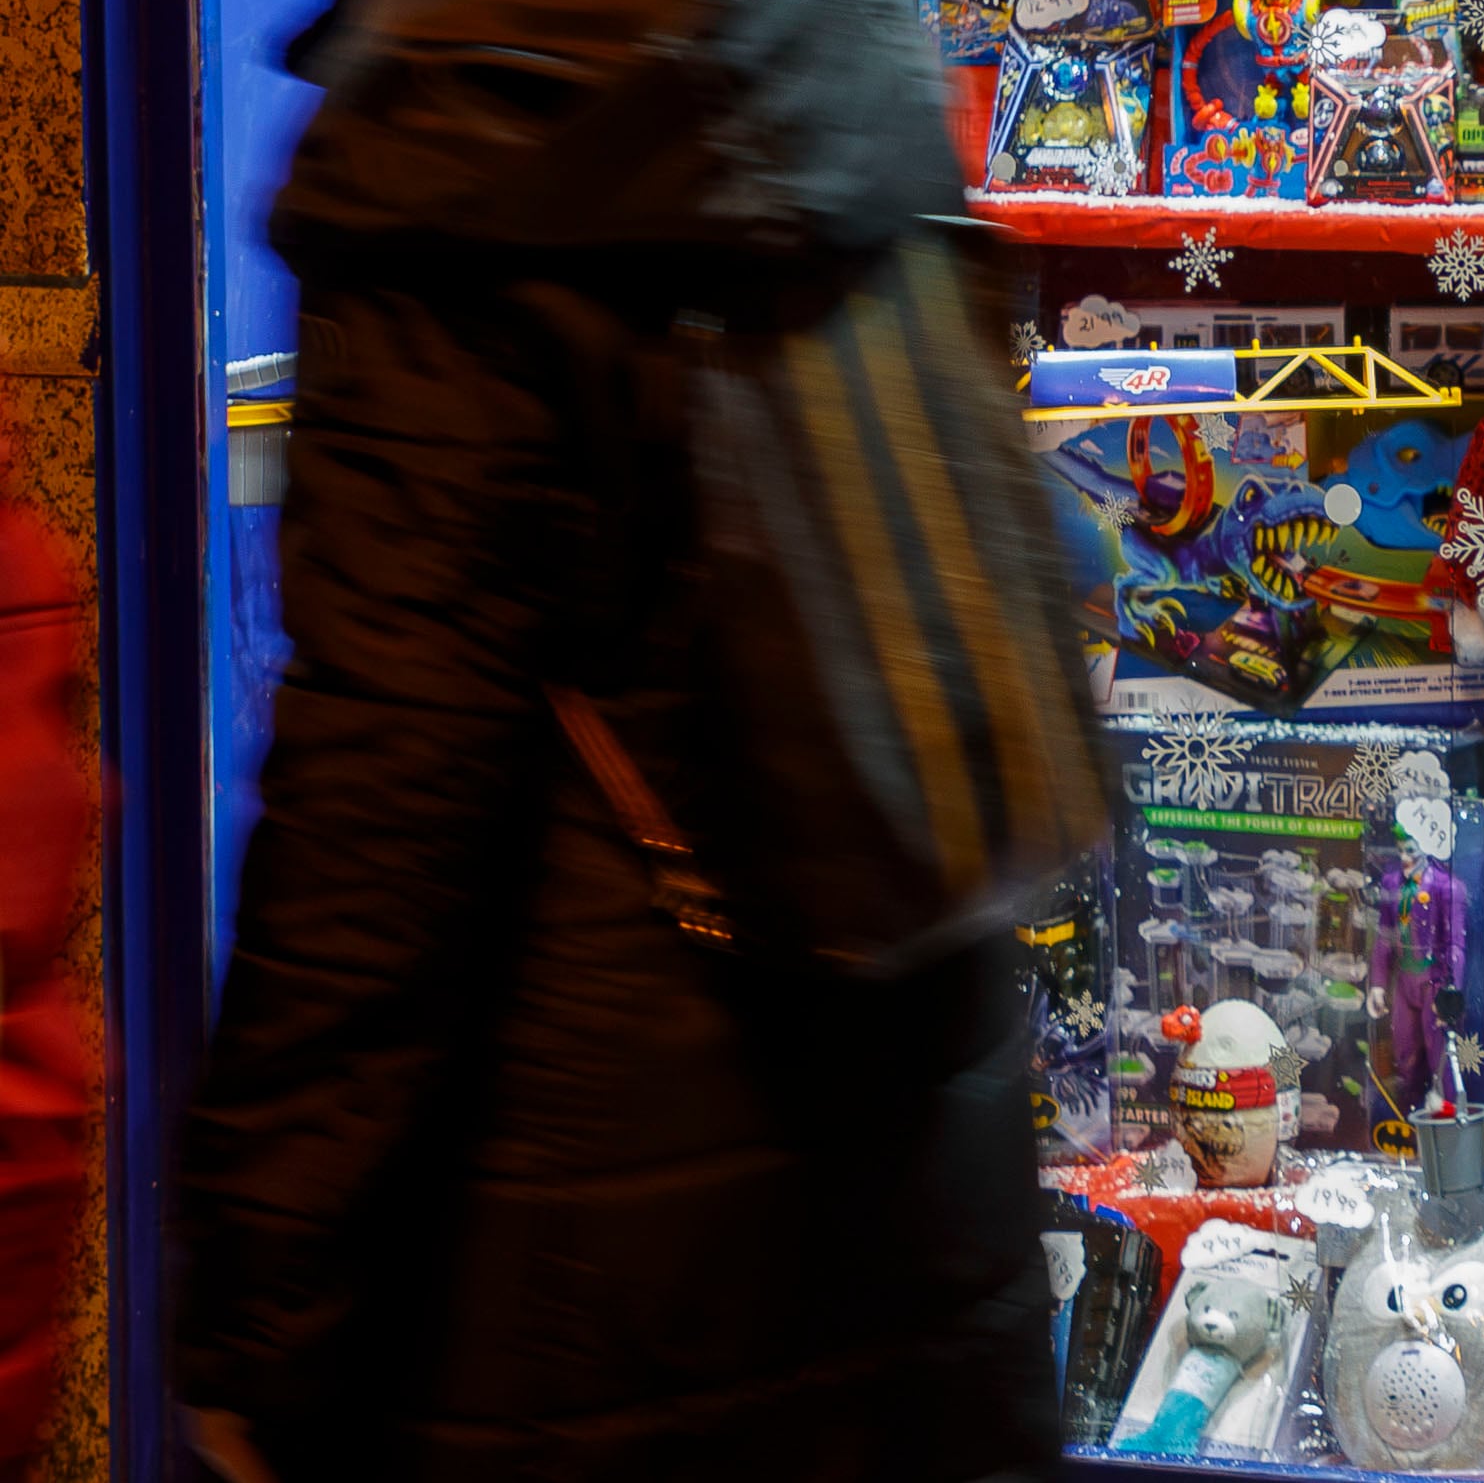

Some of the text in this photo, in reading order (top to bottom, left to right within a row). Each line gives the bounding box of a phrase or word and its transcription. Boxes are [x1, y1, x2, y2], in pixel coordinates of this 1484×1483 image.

[1407, 2, 1458, 23] SMASH
[1221, 814, 1242, 830] THE
[1245, 816, 1286, 833] POWER
[1307, 820, 1356, 838] GRAVITY
[1185, 1091, 1236, 1109] ISLAND
